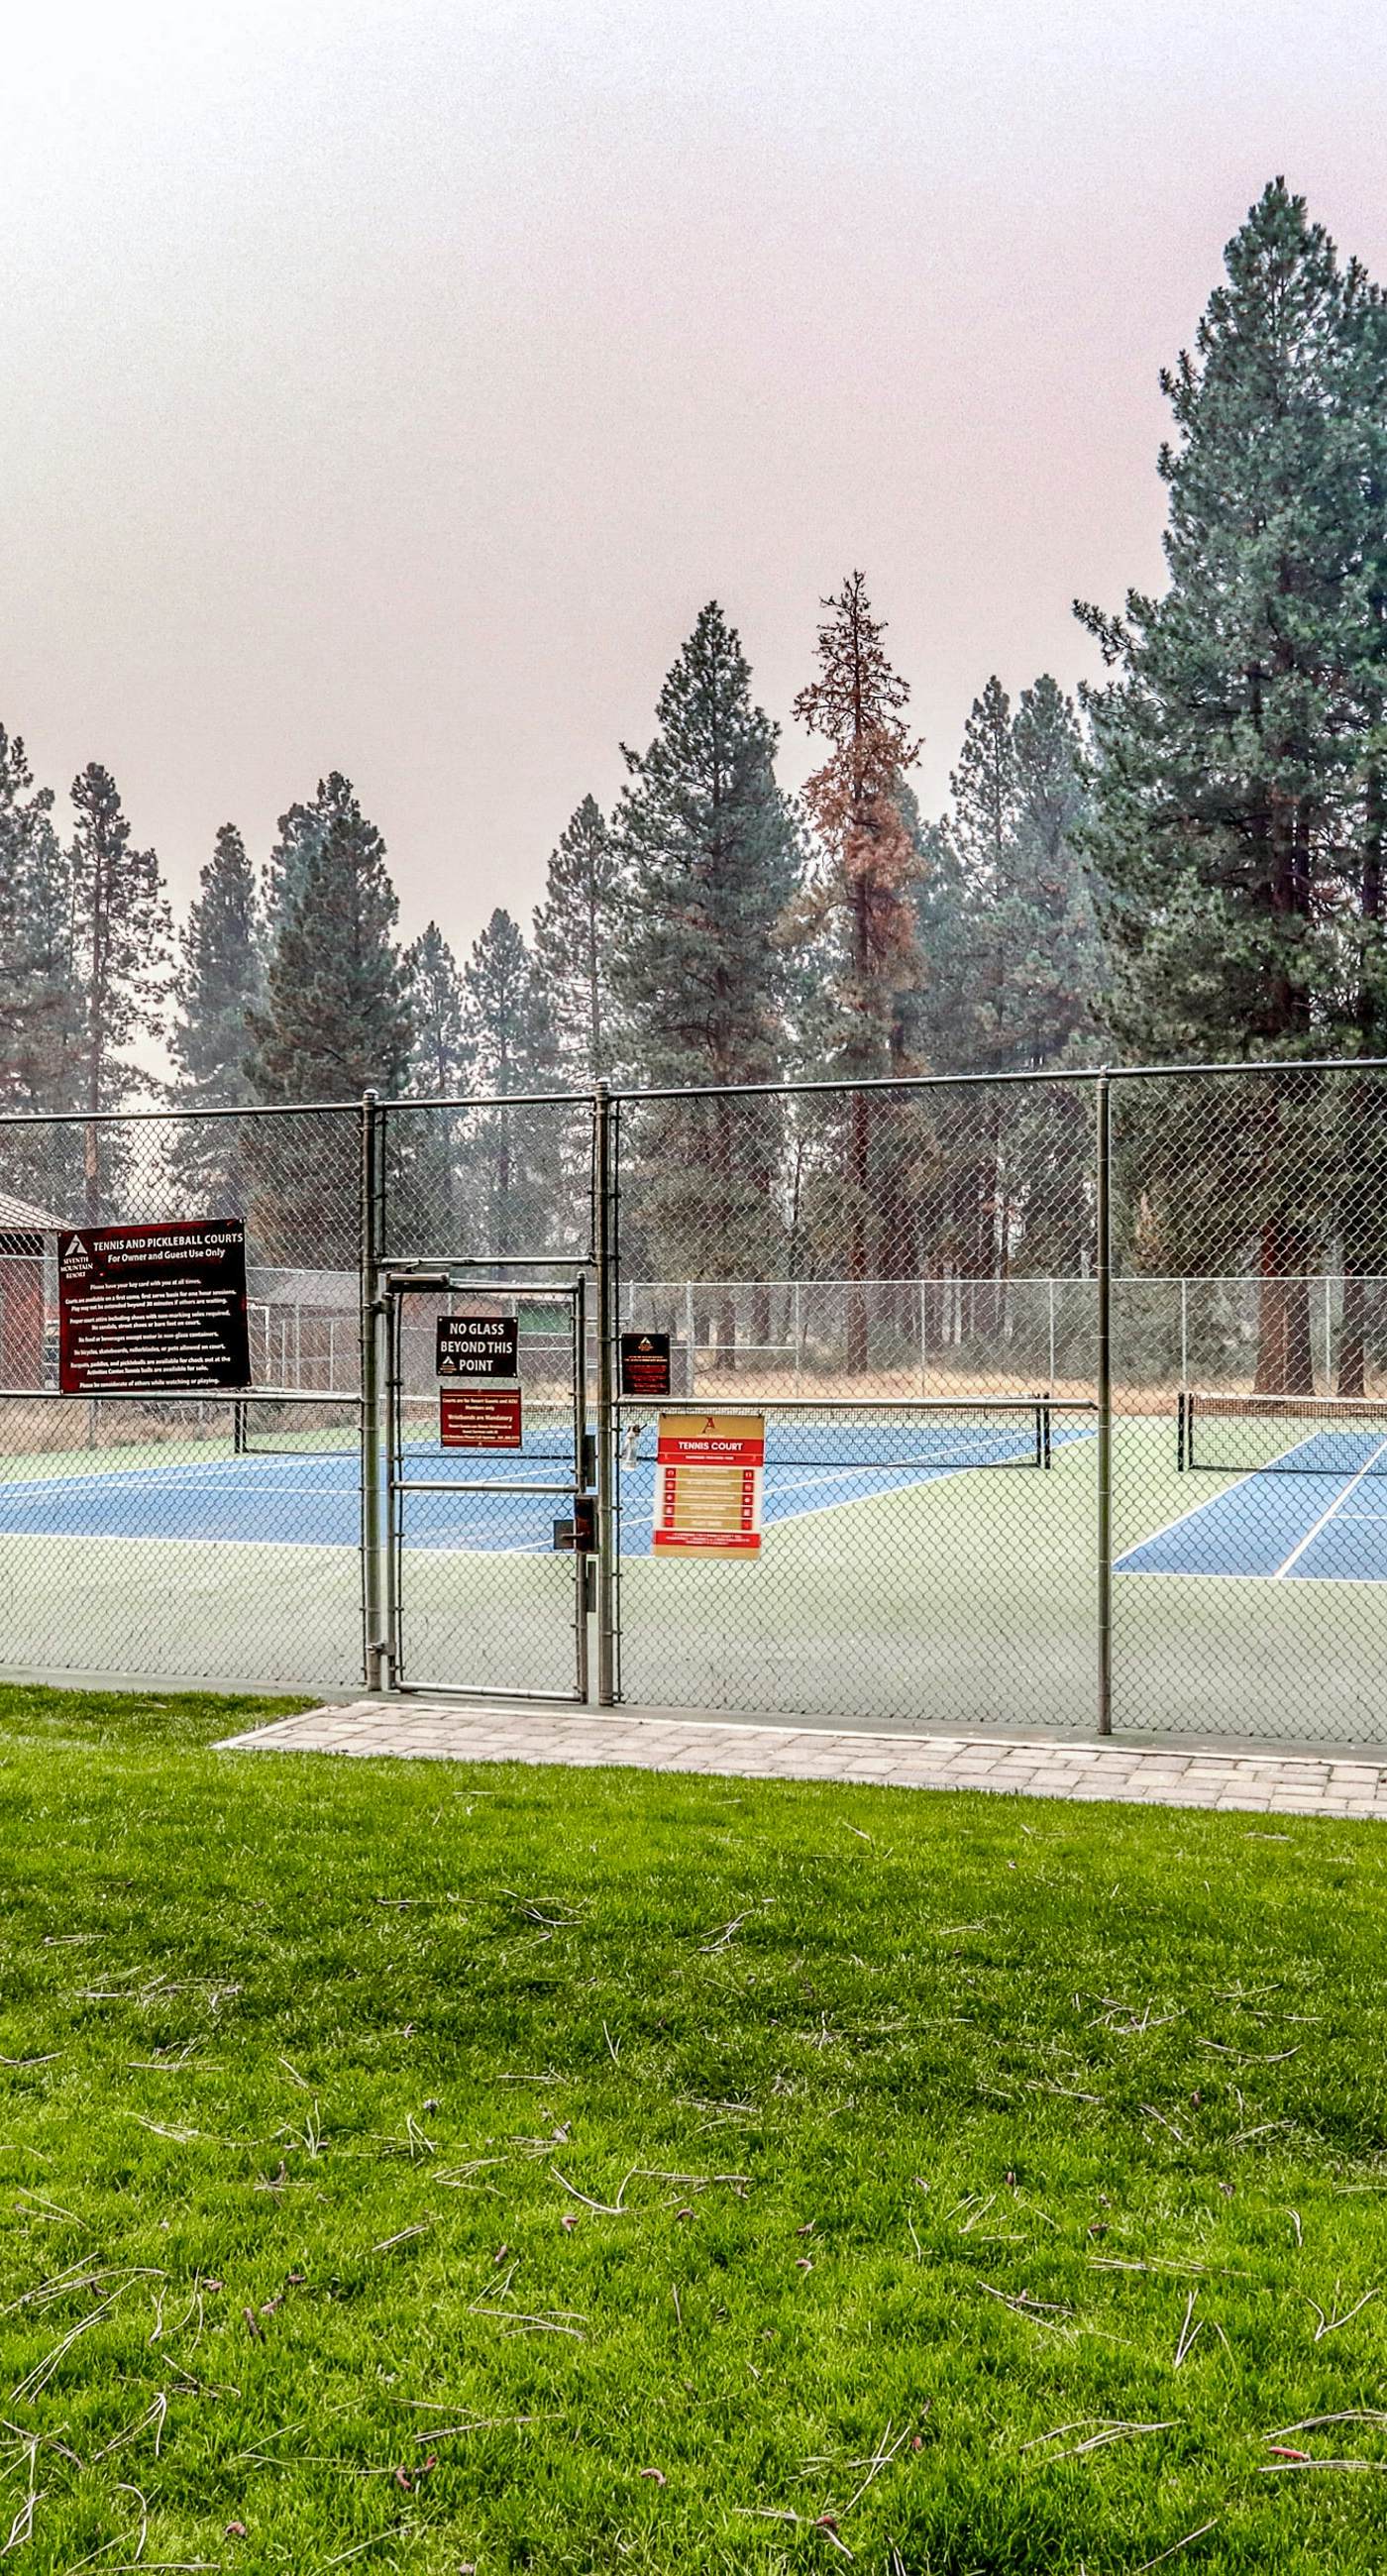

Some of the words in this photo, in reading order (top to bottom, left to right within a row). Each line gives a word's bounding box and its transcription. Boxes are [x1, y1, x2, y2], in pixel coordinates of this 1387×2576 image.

[93, 1240, 125, 1252] TENNIS
[126, 1238, 146, 1249] AND
[148, 1235, 202, 1248] PICKLEBALL
[204, 1233, 244, 1244] COURTS
[108, 1253, 120, 1263] For
[122, 1252, 147, 1263] Owner
[149, 1250, 163, 1260] and
[164, 1250, 187, 1260] Guest
[189, 1248, 204, 1258] Use
[205, 1247, 226, 1258] Only
[60, 1262, 93, 1272] MOUNTAIN
[450, 1323, 467, 1335] NO
[469, 1323, 504, 1336] GLASS
[441, 1341, 485, 1353] BEYOND
[486, 1342, 512, 1353] THIS
[460, 1359, 493, 1371] POINT
